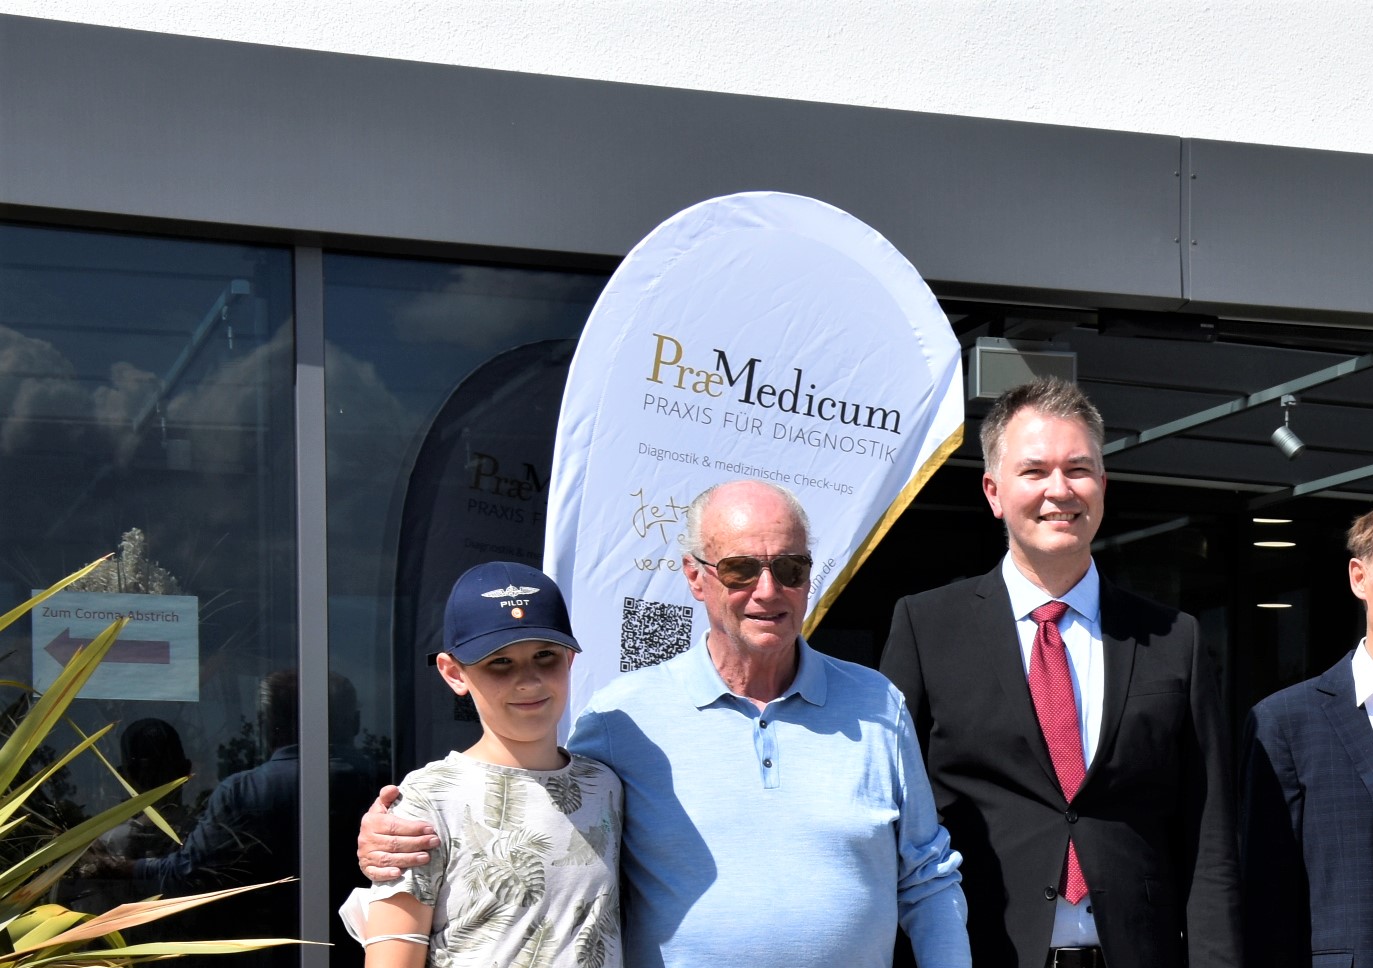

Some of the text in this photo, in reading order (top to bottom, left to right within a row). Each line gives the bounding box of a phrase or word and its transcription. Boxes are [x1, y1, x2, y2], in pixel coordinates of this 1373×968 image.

[646, 333, 901, 435] PræMedicum
[643, 393, 897, 464] PRAXIS FÜR DIAGNOSTIK
[638, 442, 854, 495] Diagnostik & medizinische Check-ups
[467, 498, 524, 523] PRAXIS
[43, 607, 71, 619] Zum
[500, 599, 530, 608] PILOT
